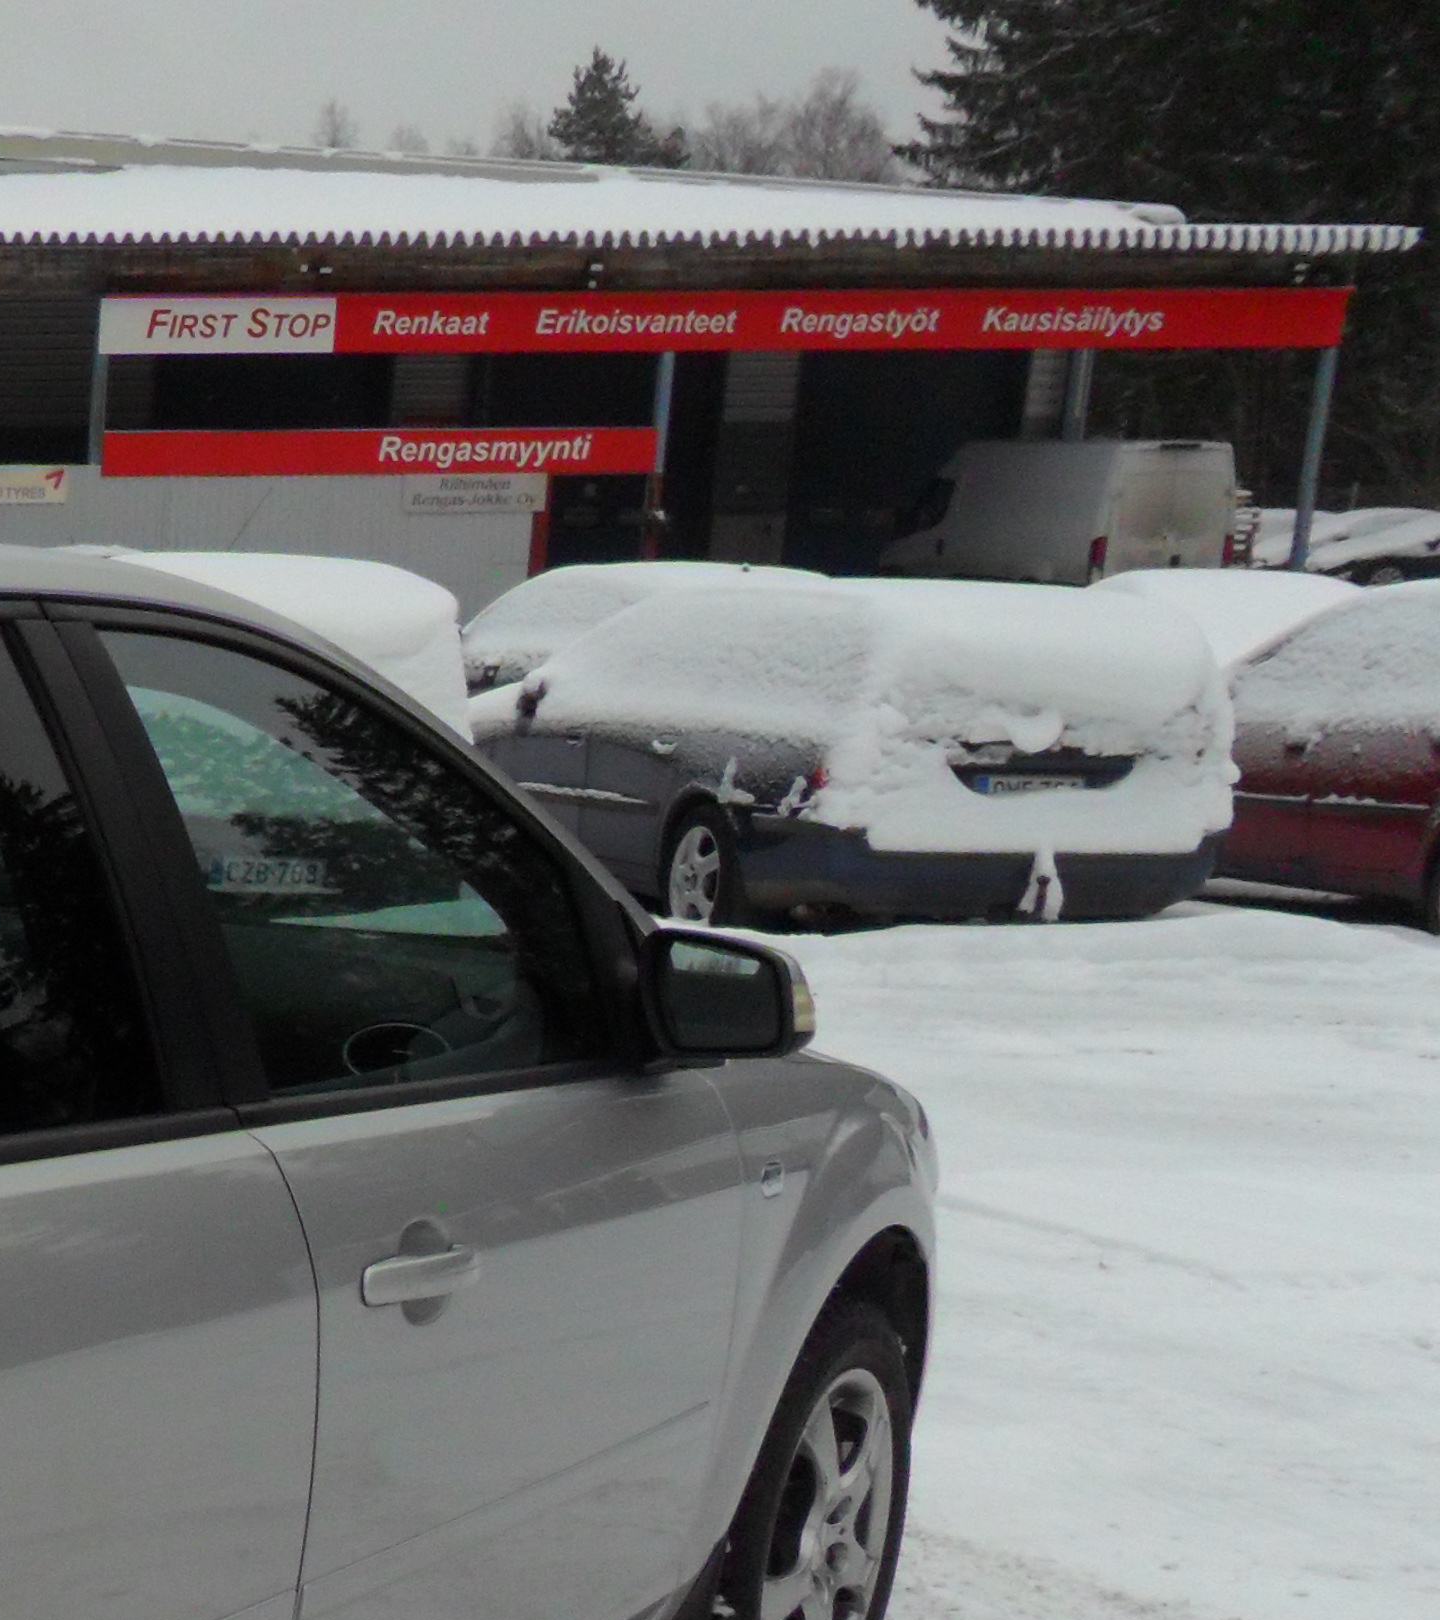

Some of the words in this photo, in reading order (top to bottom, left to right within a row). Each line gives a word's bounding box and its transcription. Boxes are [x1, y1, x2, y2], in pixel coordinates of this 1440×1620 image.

[145, 308, 239, 339] FIRST
[246, 307, 332, 339] STOP
[372, 309, 490, 336] Renkaat
[534, 308, 738, 335] Erikoisvanteet
[779, 306, 942, 339] Rengastyöt
[981, 306, 1165, 338] Kausisäilytys
[378, 433, 593, 469] Rengasmyynti
[6, 486, 46, 500] TYRES
